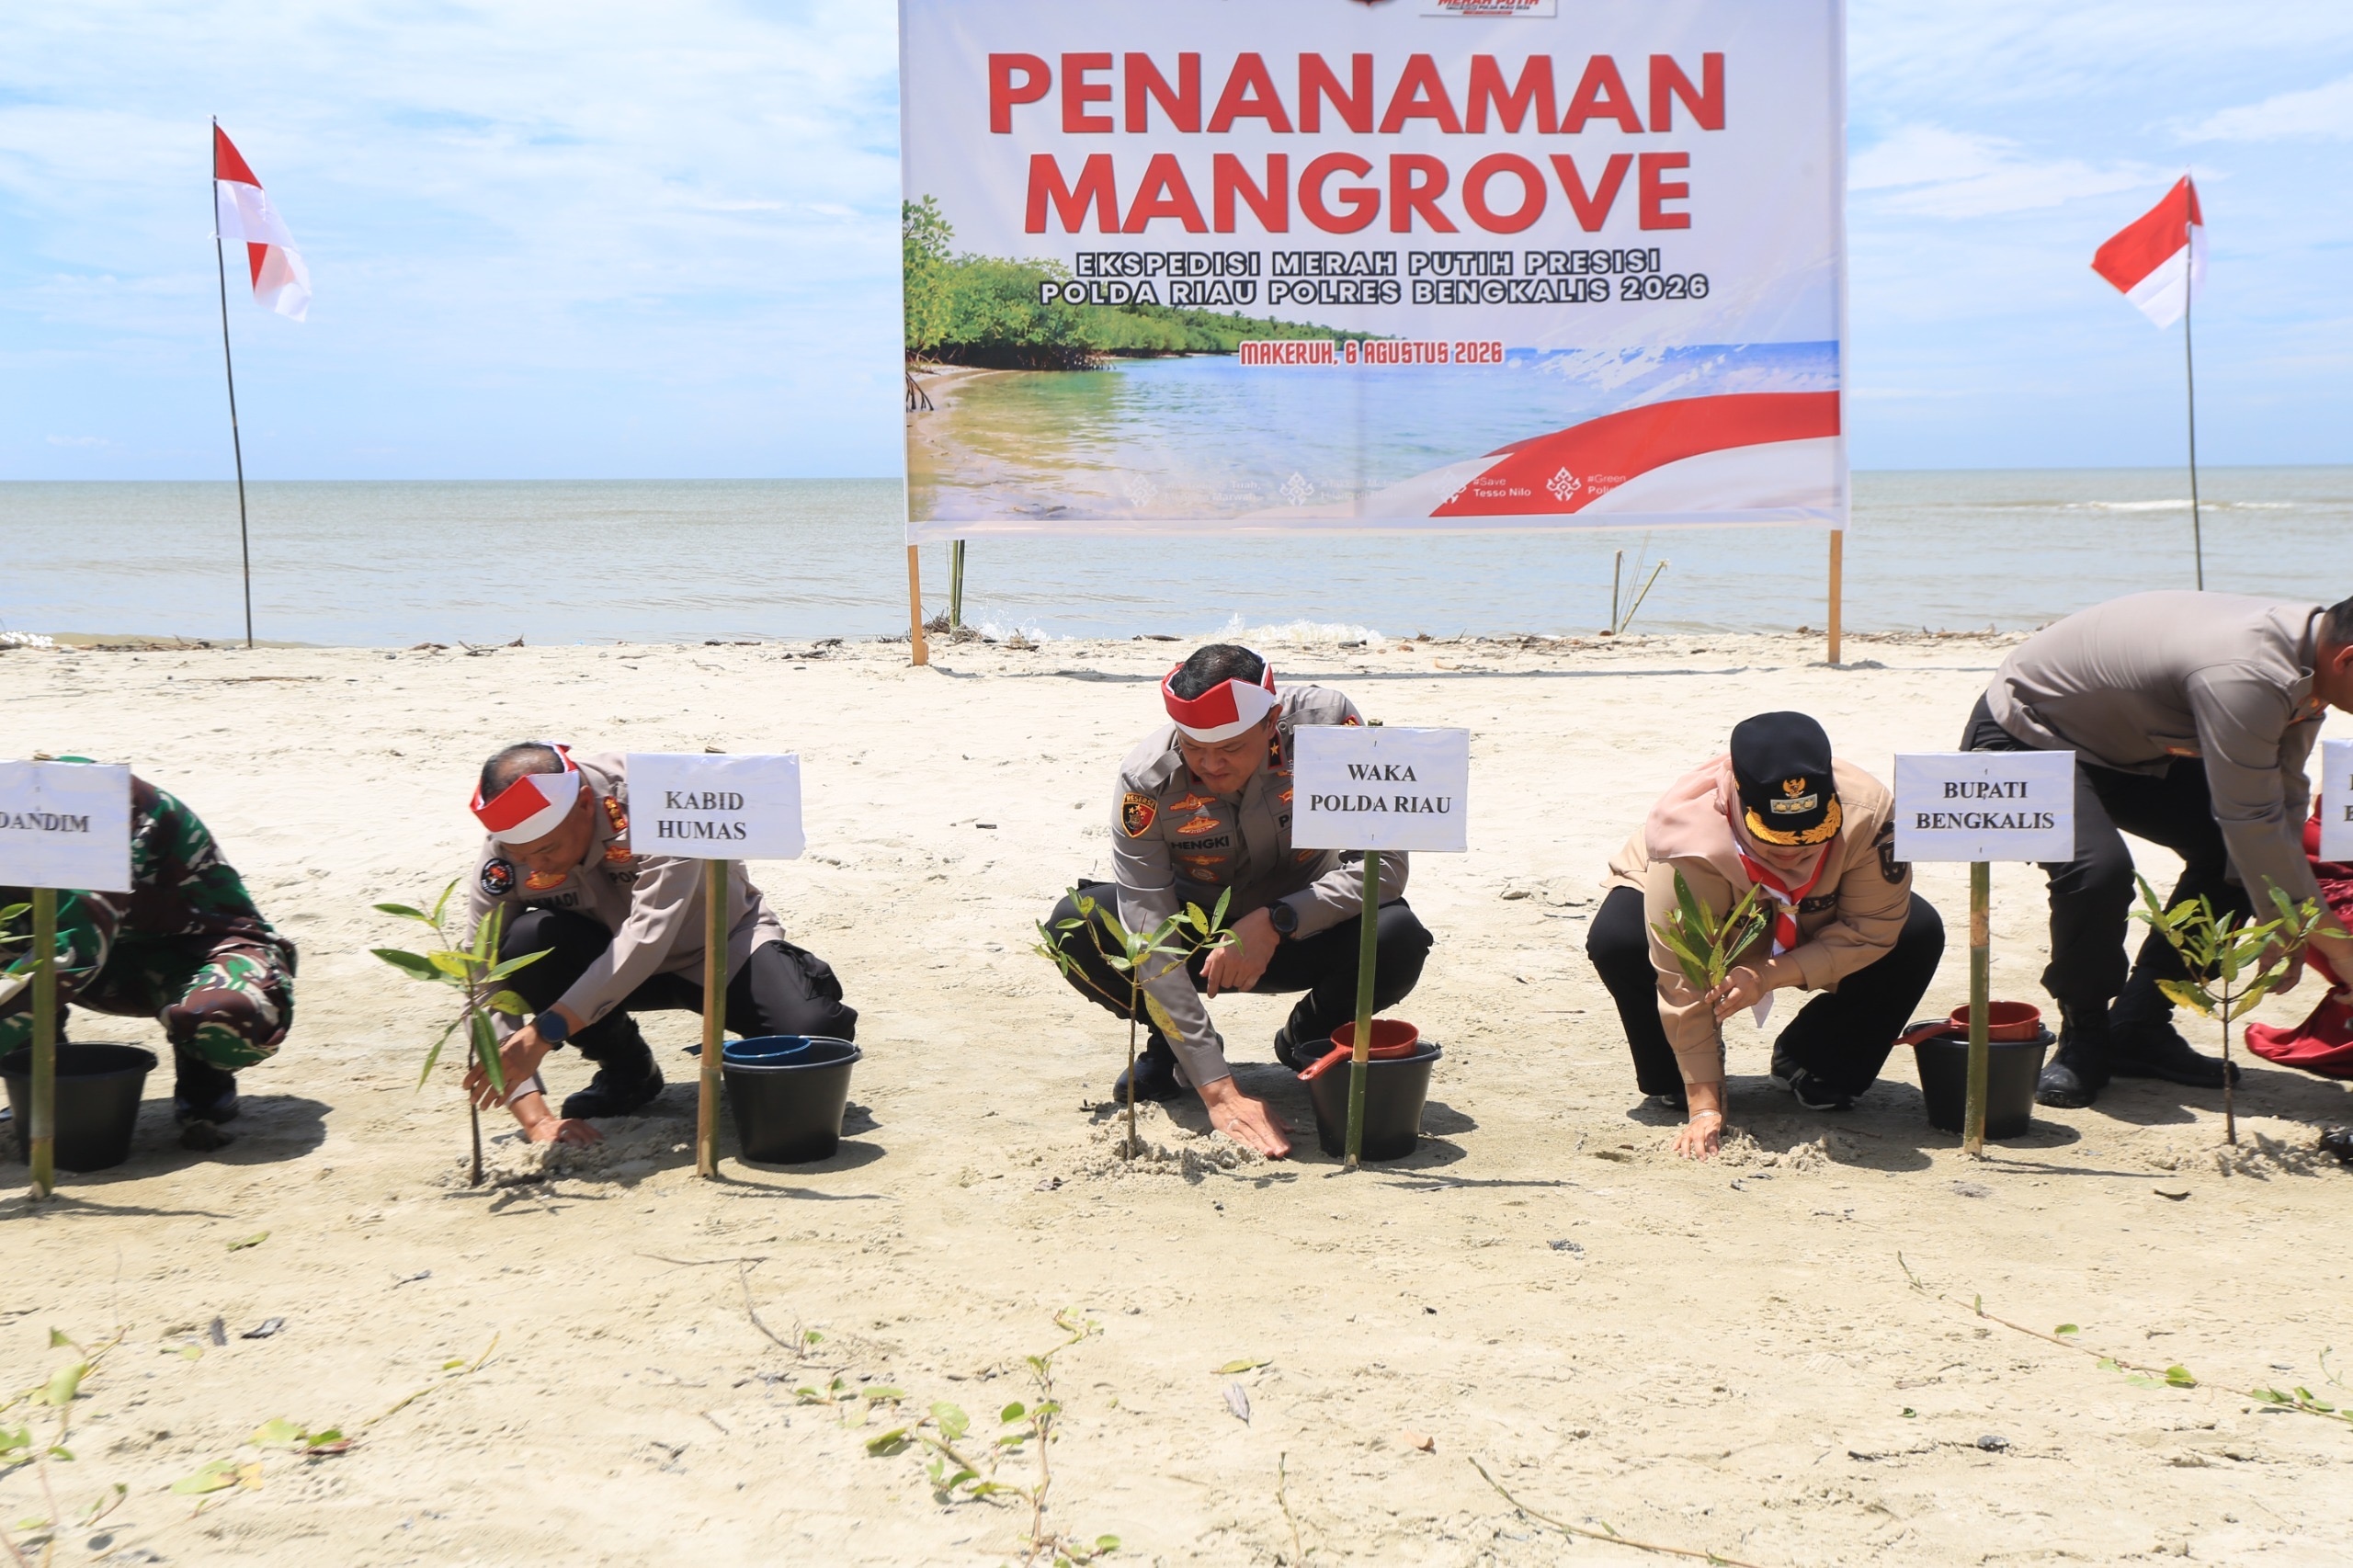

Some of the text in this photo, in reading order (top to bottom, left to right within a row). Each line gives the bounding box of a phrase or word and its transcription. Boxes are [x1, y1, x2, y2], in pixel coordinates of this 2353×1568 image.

[988, 51, 1726, 134] PENANAMAN
[1024, 151, 1692, 234] MANGROVE
[1075, 248, 1661, 277] EKSPEDISI MERAH PUTIH PRESISI
[1039, 273, 1710, 305] POLDA RIAU POLRES BENGKALIS 2026
[1241, 341, 1503, 365] MAKERUH, 6 AGUSTUS 2026
[1472, 477, 1506, 486] #Save
[1587, 474, 1627, 483] #Green
[1473, 488, 1532, 497] Tesso Nilo
[1347, 764, 1417, 782] WAKA
[1943, 781, 2029, 799] BUPATI
[665, 790, 745, 811] KABID
[1126, 794, 1155, 808] RESERSE
[1310, 794, 1452, 813] POLDA RIAU
[1915, 812, 2055, 829] BENGKALIS
[656, 820, 746, 840] HUMAS
[1171, 835, 1230, 850] HENGKI
